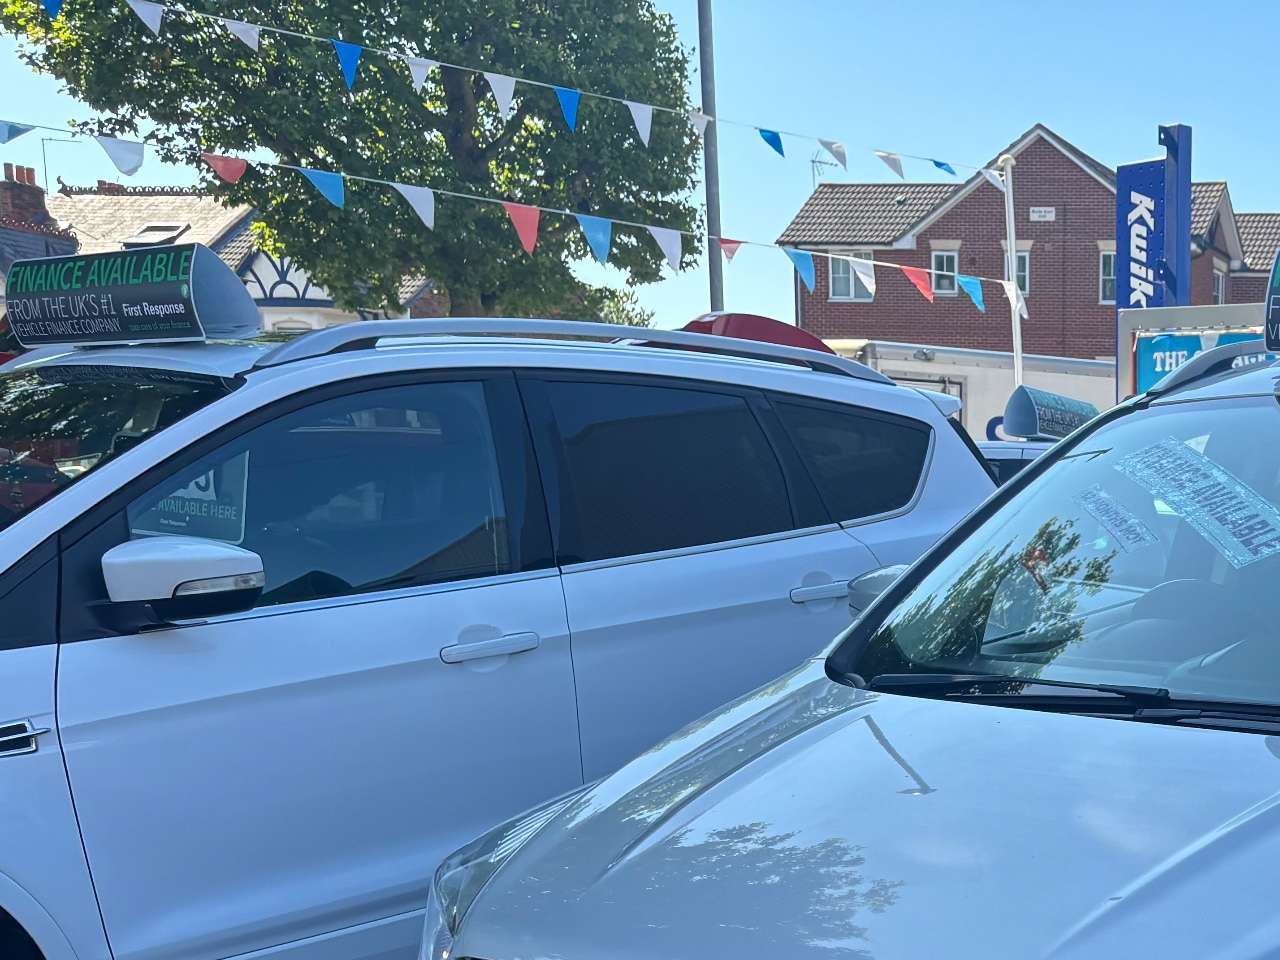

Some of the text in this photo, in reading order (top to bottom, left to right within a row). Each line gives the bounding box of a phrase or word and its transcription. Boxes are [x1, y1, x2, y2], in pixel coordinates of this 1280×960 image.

[1127, 190, 1155, 309] Kwik
[6, 250, 193, 294] FINANCE AVAILABLE
[7, 293, 117, 321] FROM THE UK'S #1
[123, 302, 185, 318] First Response
[14, 320, 49, 338] VEHICLE
[49, 318, 81, 337] FINANCE
[80, 316, 122, 335] COMPANY
[158, 498, 238, 520] AVAILABLE HERE
